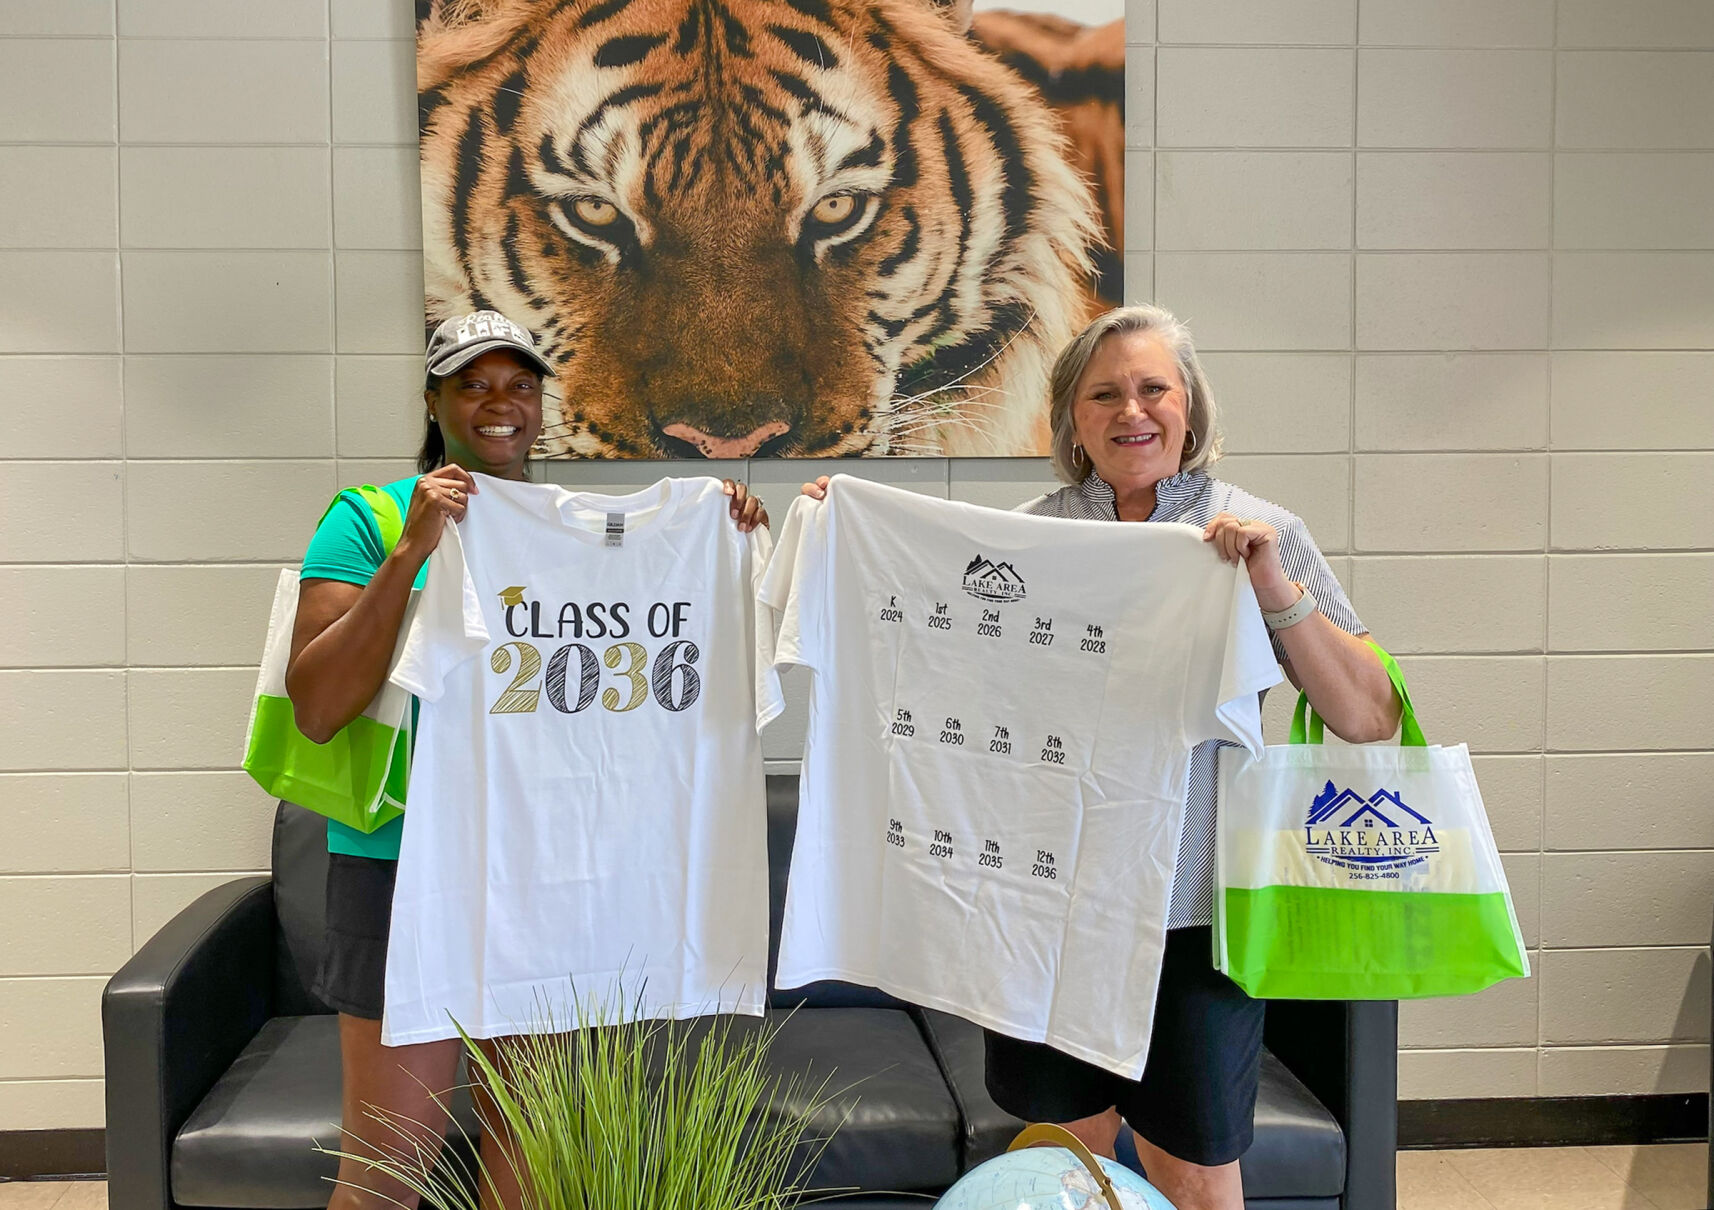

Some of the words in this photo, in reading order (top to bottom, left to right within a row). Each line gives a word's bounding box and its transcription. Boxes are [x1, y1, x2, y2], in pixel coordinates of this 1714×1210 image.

[962, 575, 994, 590] LAKE
[996, 582, 1026, 594] AREA
[890, 595, 897, 608] K
[935, 602, 948, 616] 1st
[504, 600, 630, 638] CLASS
[647, 601, 692, 638] OF
[880, 608, 903, 623] 2024
[927, 615, 952, 631] 2025
[981, 608, 1001, 623] 2nd
[976, 622, 1002, 638] 2026
[1034, 616, 1053, 631] 3rd
[1086, 624, 1103, 638] 4th
[1029, 630, 1055, 646] 2027
[1080, 638, 1106, 654] 2028
[489, 640, 701, 714] 2036
[897, 708, 912, 723] 5th
[891, 721, 915, 737] 2029
[945, 717, 961, 731] 6th
[939, 730, 965, 746] 2030
[994, 726, 1009, 740] 7th
[989, 739, 1012, 755] 2031
[1046, 735, 1062, 749] 8th
[1040, 748, 1066, 765] 2032
[890, 818, 903, 833] 9th
[886, 830, 905, 848] 2033
[934, 829, 952, 844] 10th
[1304, 826, 1368, 846] LAKE
[1376, 826, 1438, 846] AREA
[929, 843, 954, 859] 2034
[985, 839, 1000, 854] 11th
[1331, 846, 1384, 856] REALTY,
[1389, 846, 1415, 855] INC.
[978, 852, 1003, 869] 2035
[1036, 850, 1055, 865] 12th
[1320, 856, 1346, 868] HELPING
[1347, 862, 1360, 870] YOU
[1376, 863, 1393, 871] YOUR
[1407, 856, 1425, 866] HOME
[1031, 863, 1057, 880] 2036
[1349, 871, 1400, 880] 256-825-4800
